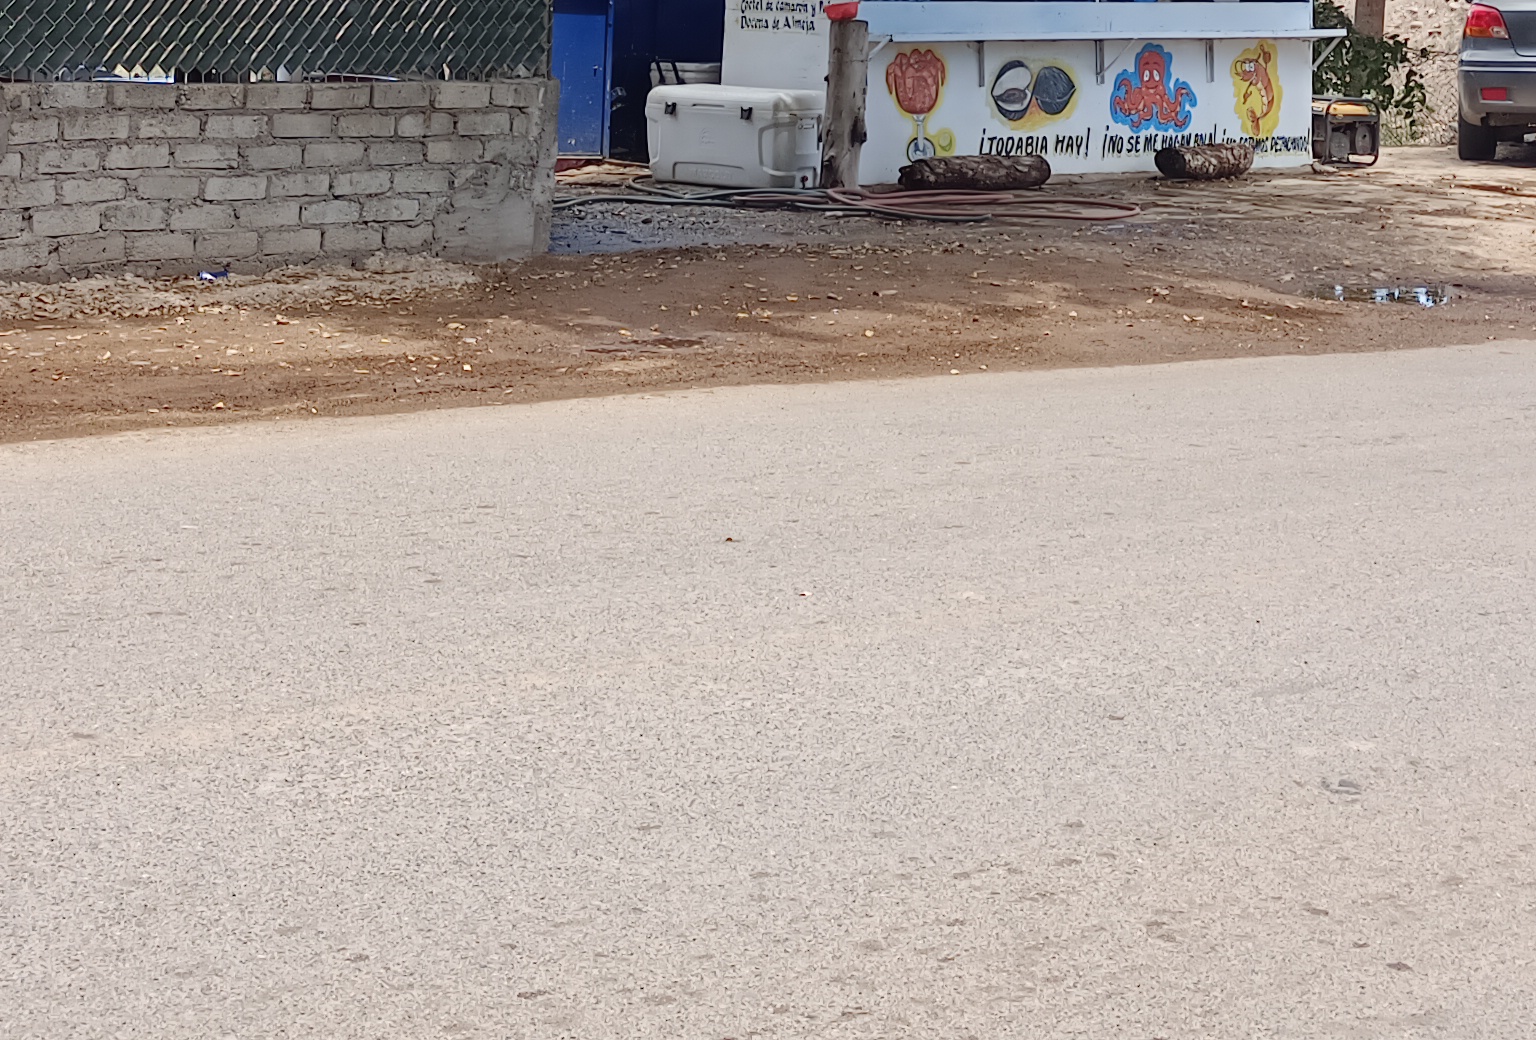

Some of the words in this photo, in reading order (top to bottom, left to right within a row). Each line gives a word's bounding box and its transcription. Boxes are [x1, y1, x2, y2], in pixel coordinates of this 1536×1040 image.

[810, 2, 816, 17] y
[783, 15, 816, 34] Almeja
[1054, 126, 1091, 157] HAY!
[1126, 134, 1141, 154] SE
[1143, 133, 1159, 154] ME
